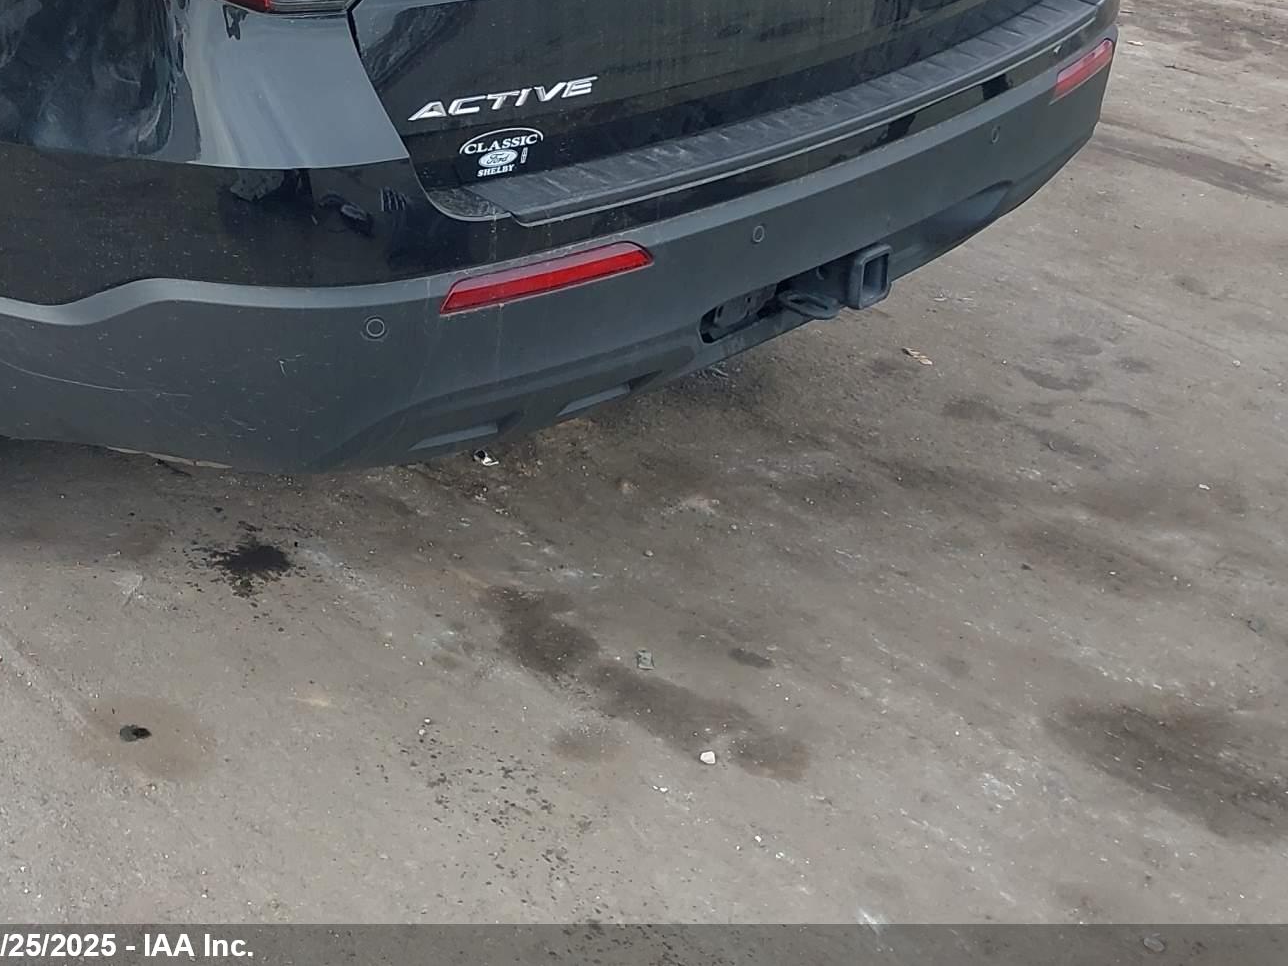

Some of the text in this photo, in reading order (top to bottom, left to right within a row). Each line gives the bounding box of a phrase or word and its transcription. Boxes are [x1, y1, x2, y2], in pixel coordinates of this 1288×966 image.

[407, 75, 599, 121] ACTIVE
[464, 133, 538, 155] CLASSIC
[476, 163, 516, 177] SHELBY
